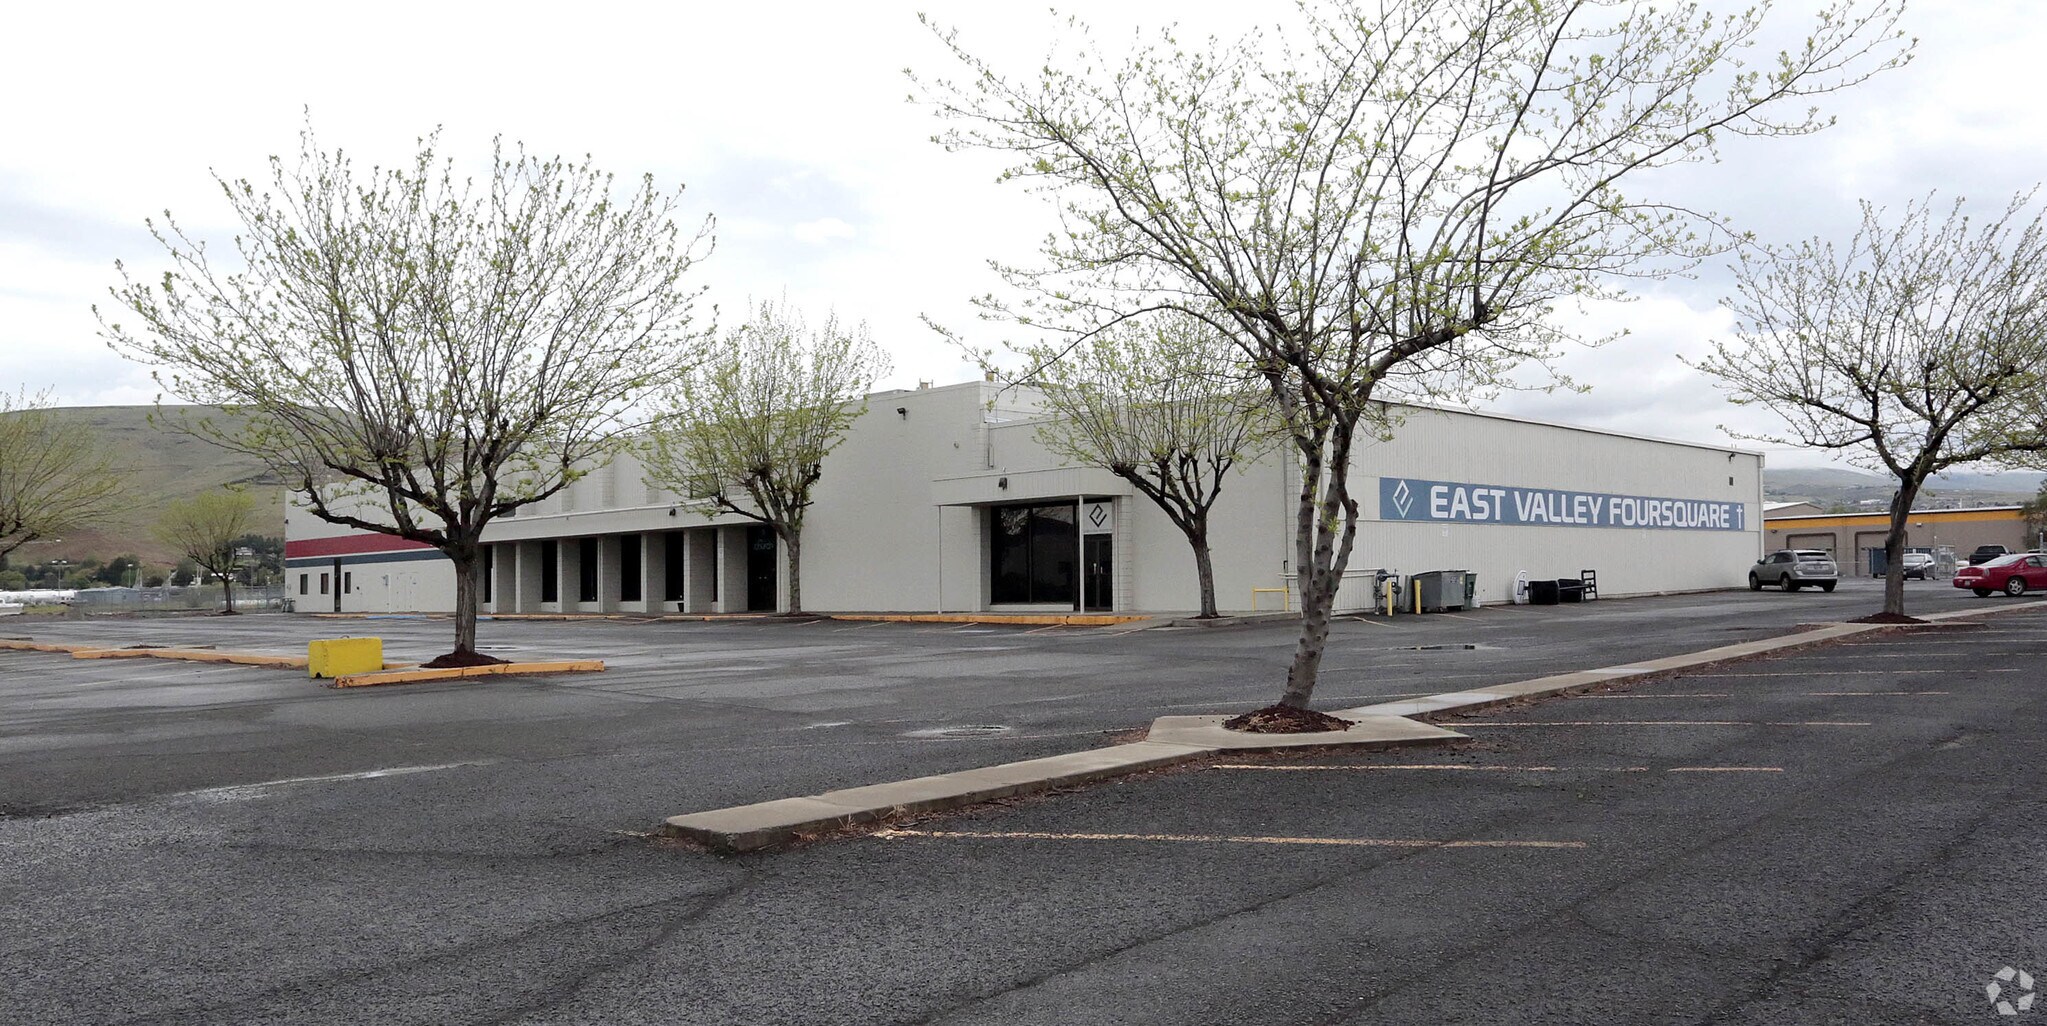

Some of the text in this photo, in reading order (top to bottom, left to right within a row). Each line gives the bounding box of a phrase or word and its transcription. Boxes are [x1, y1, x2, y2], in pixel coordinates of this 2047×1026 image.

[1431, 485, 1730, 528] EAST VALLEY FOURSQUARE
